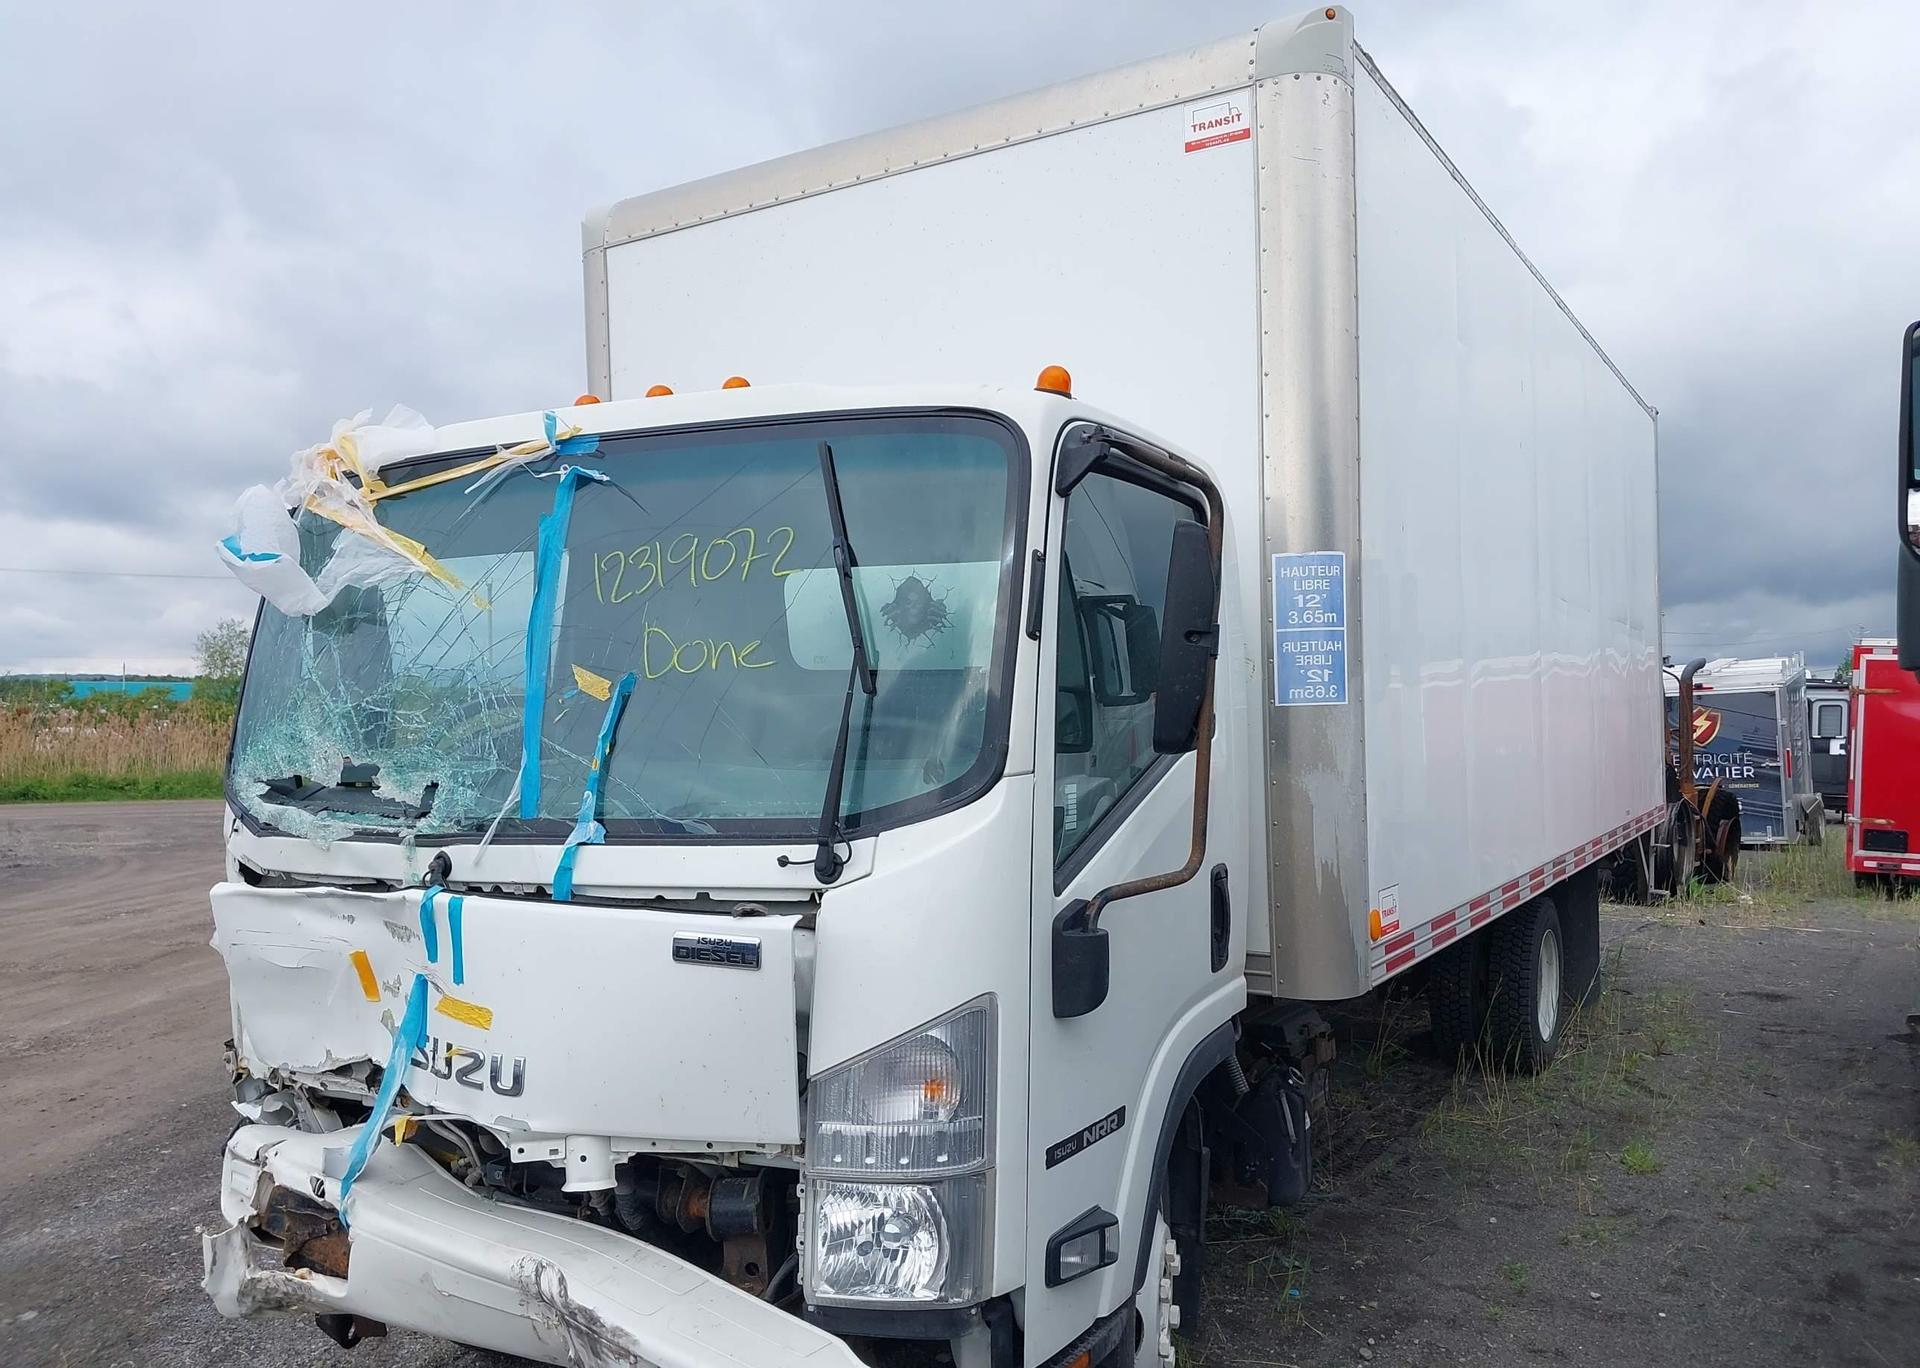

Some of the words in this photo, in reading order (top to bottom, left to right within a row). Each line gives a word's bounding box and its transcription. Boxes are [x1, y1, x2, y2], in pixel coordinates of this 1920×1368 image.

[1191, 113, 1242, 133] TRANSIT
[594, 526, 805, 605] 12319072
[1281, 565, 1341, 578] HAUTEUR
[1293, 579, 1331, 591] LIBRE
[1288, 610, 1337, 624] 3.65m
[643, 621, 777, 679] Done
[697, 936, 733, 947] ISUZU
[675, 945, 755, 965] DIESEL
[410, 1035, 527, 1098] SUZU
[1054, 1139, 1078, 1161] ISUZU
[1083, 1113, 1119, 1148] NRR
